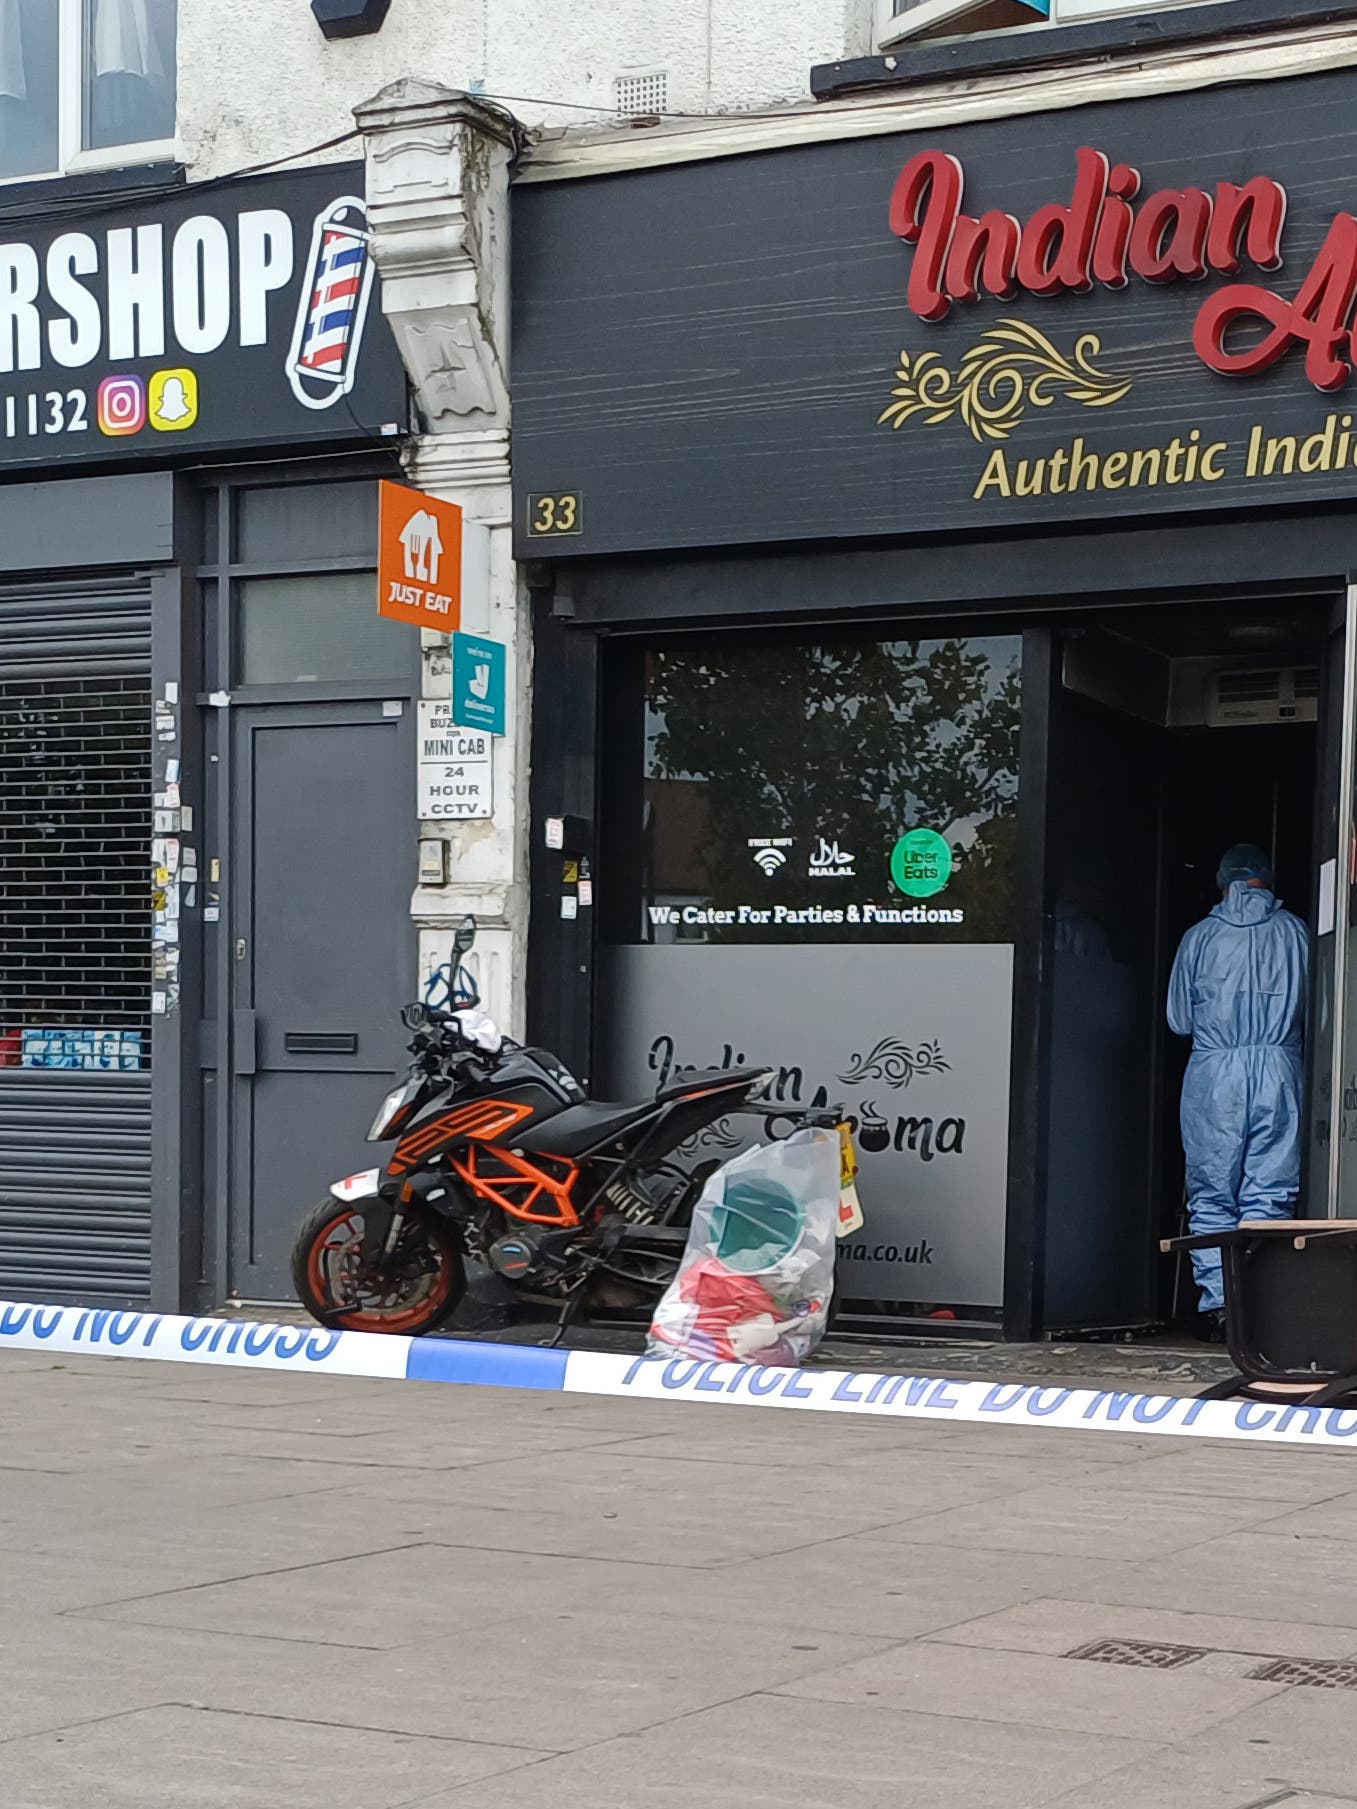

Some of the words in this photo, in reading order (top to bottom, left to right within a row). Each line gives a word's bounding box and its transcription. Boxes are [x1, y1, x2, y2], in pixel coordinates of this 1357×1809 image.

[889, 146, 1287, 324] Indian
[0, 209, 294, 373] RSHOP
[973, 430, 1225, 500] Authentic
[534, 495, 577, 532] 33
[388, 581, 424, 607] JUST
[425, 591, 453, 615] EAT
[424, 739, 454, 757] MINI
[458, 738, 486, 756] CAB
[444, 767, 465, 778] 24
[429, 785, 480, 796] HOUR
[431, 803, 479, 814] CCTV
[904, 851, 939, 864] Uber
[808, 866, 857, 876] HALAL
[904, 866, 939, 880] Eats
[648, 906, 681, 924] We
[682, 906, 736, 924] Cater
[738, 906, 771, 923] For
[773, 905, 844, 924] Parties
[846, 906, 861, 923] &
[862, 904, 964, 924] Functions
